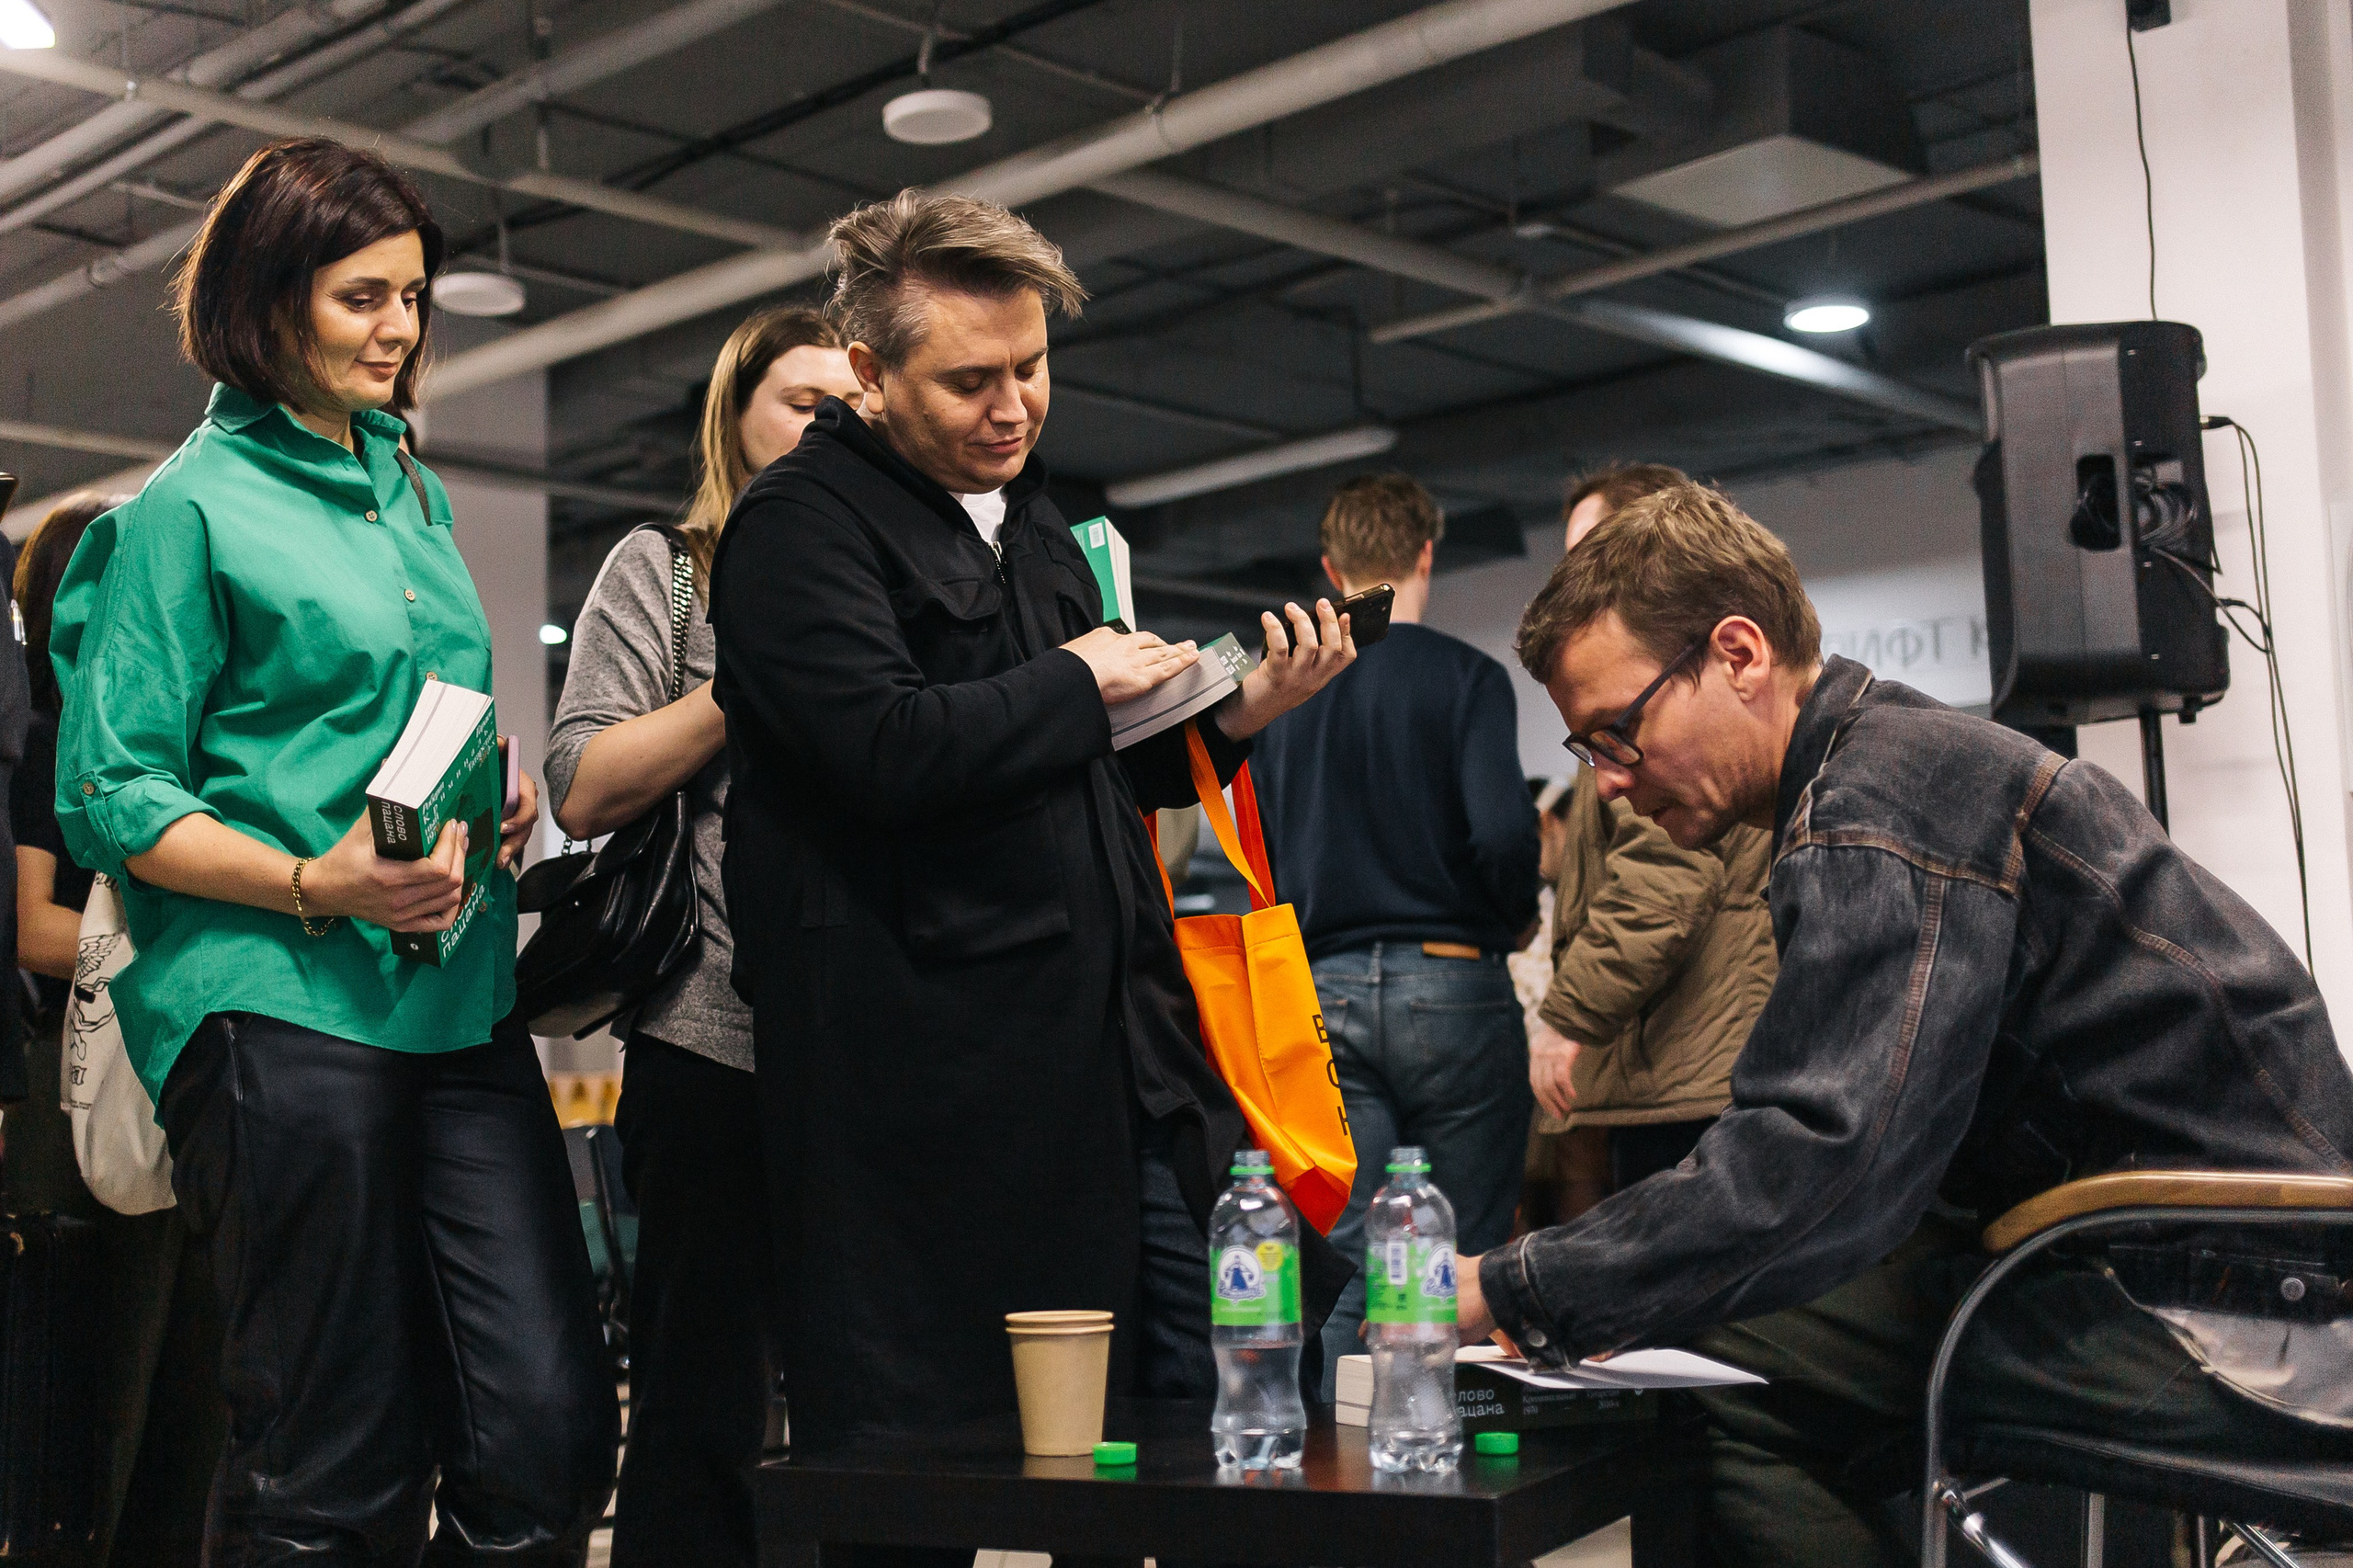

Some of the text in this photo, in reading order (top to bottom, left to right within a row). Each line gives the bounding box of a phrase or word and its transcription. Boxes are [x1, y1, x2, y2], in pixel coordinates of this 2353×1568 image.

[381, 801, 396, 845] пацана
[393, 805, 407, 841] слово
[442, 884, 485, 958] пацана
[1457, 1403, 1505, 1417] ацана
[1458, 1389, 1495, 1402] лово
